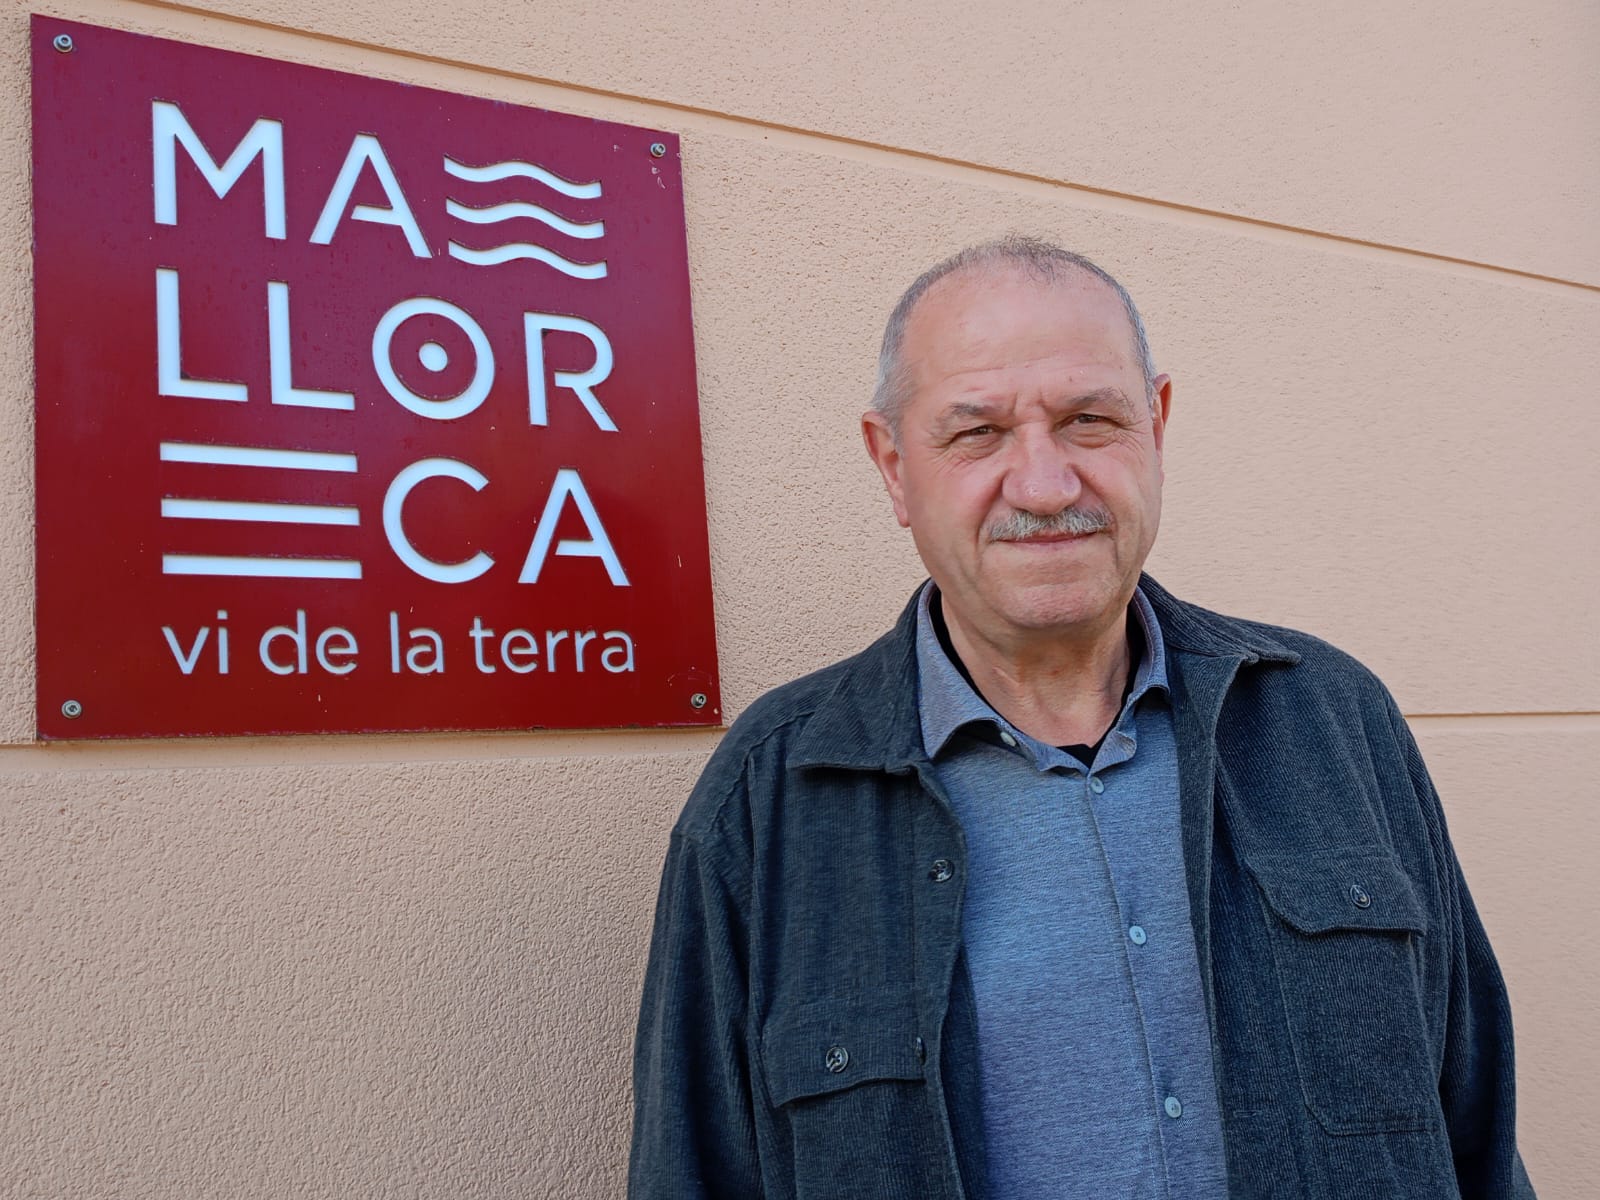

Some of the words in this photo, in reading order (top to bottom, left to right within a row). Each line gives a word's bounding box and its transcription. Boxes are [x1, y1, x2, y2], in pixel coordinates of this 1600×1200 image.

[152, 101, 433, 260] MA
[156, 269, 619, 433] LLOR
[381, 457, 631, 587] CA
[162, 610, 229, 676] vi
[258, 610, 359, 677] de
[389, 612, 445, 676] la
[468, 616, 636, 676] terra
